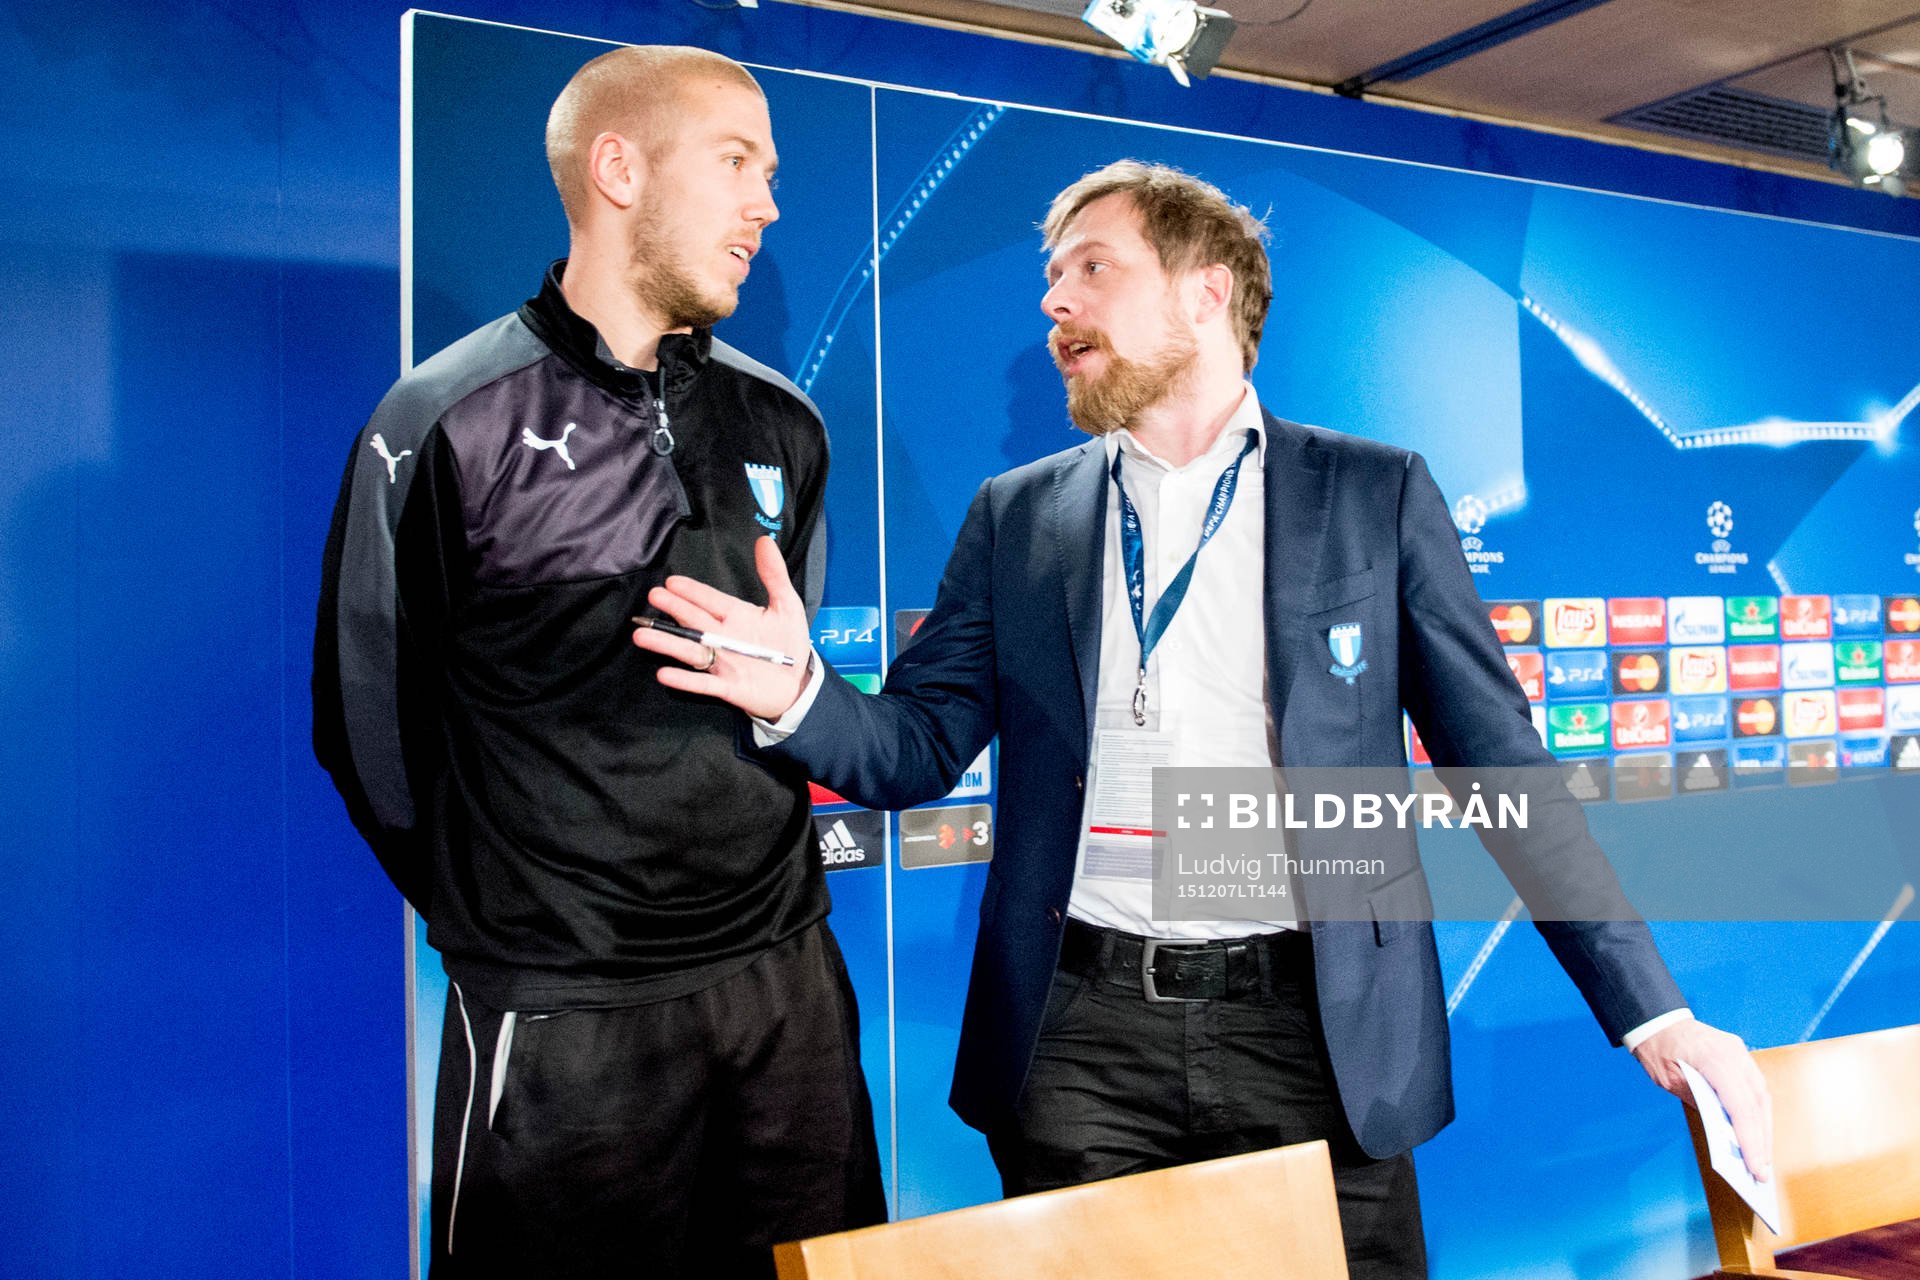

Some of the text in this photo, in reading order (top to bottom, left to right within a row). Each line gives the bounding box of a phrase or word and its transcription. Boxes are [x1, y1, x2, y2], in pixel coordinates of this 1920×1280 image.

[820, 629, 876, 645] PS4
[1568, 668, 1604, 682] PS4
[971, 821, 989, 846] 3
[821, 847, 865, 865] didas
